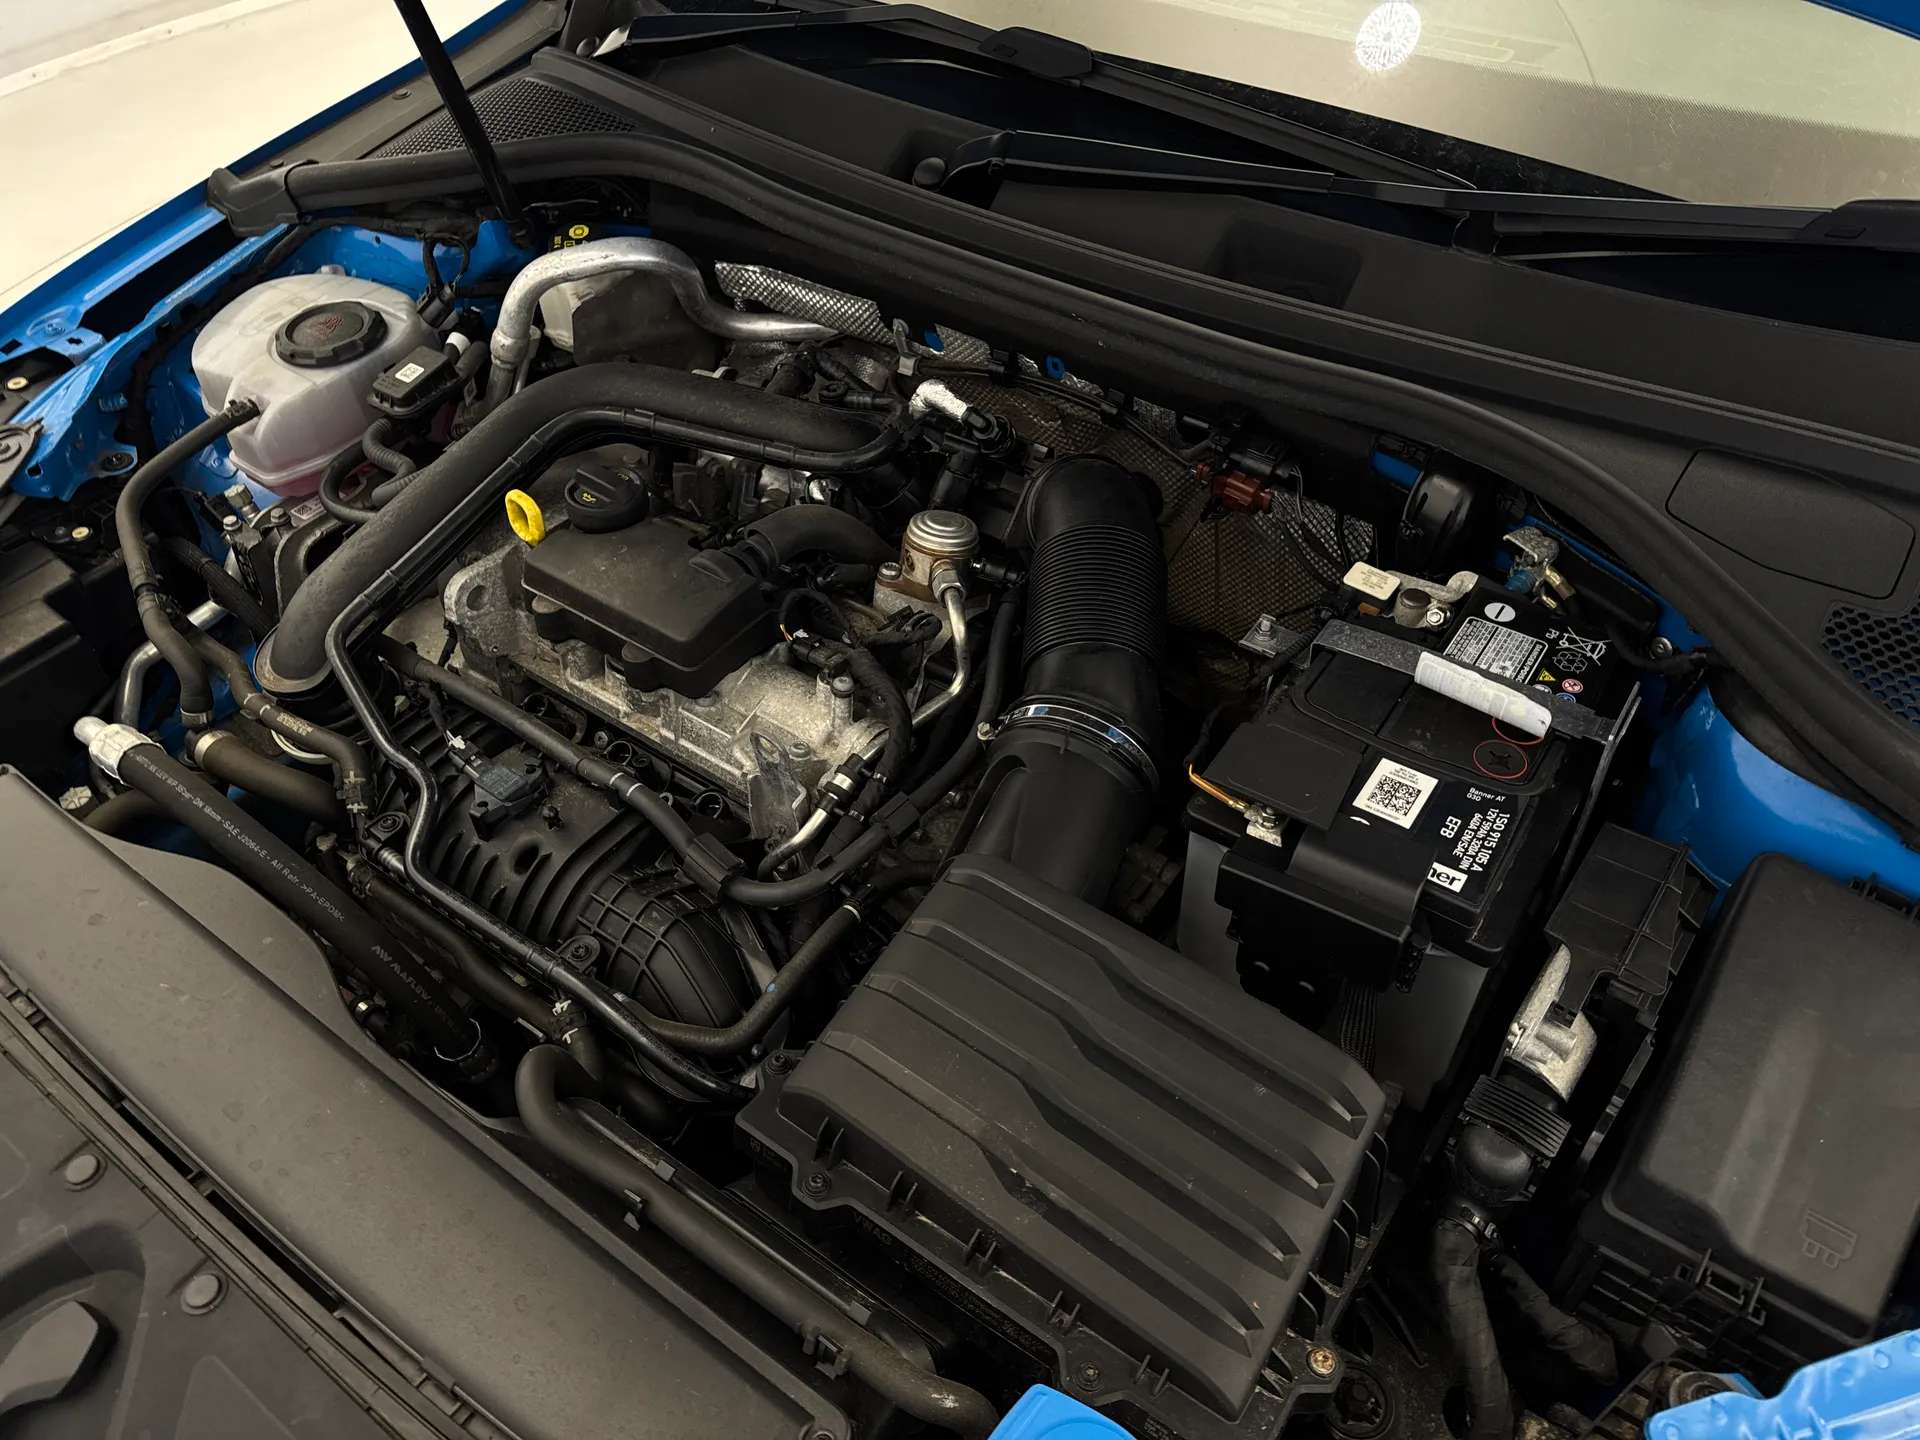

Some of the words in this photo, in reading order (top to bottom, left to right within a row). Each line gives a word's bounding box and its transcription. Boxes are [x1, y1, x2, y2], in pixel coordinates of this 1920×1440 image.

[1469, 787, 1495, 799] Banner
[1468, 812, 1483, 830] 640A
[1486, 808, 1499, 822] 12V
[1440, 815, 1461, 839] EFB
[1476, 820, 1493, 838] 59Ah
[1452, 829, 1475, 858] EN/SAE
[1468, 838, 1482, 856] 320A
[1484, 831, 1500, 848] 915
[1458, 855, 1473, 870] DIN
[1475, 848, 1492, 865] 105
[1470, 862, 1483, 872] A
